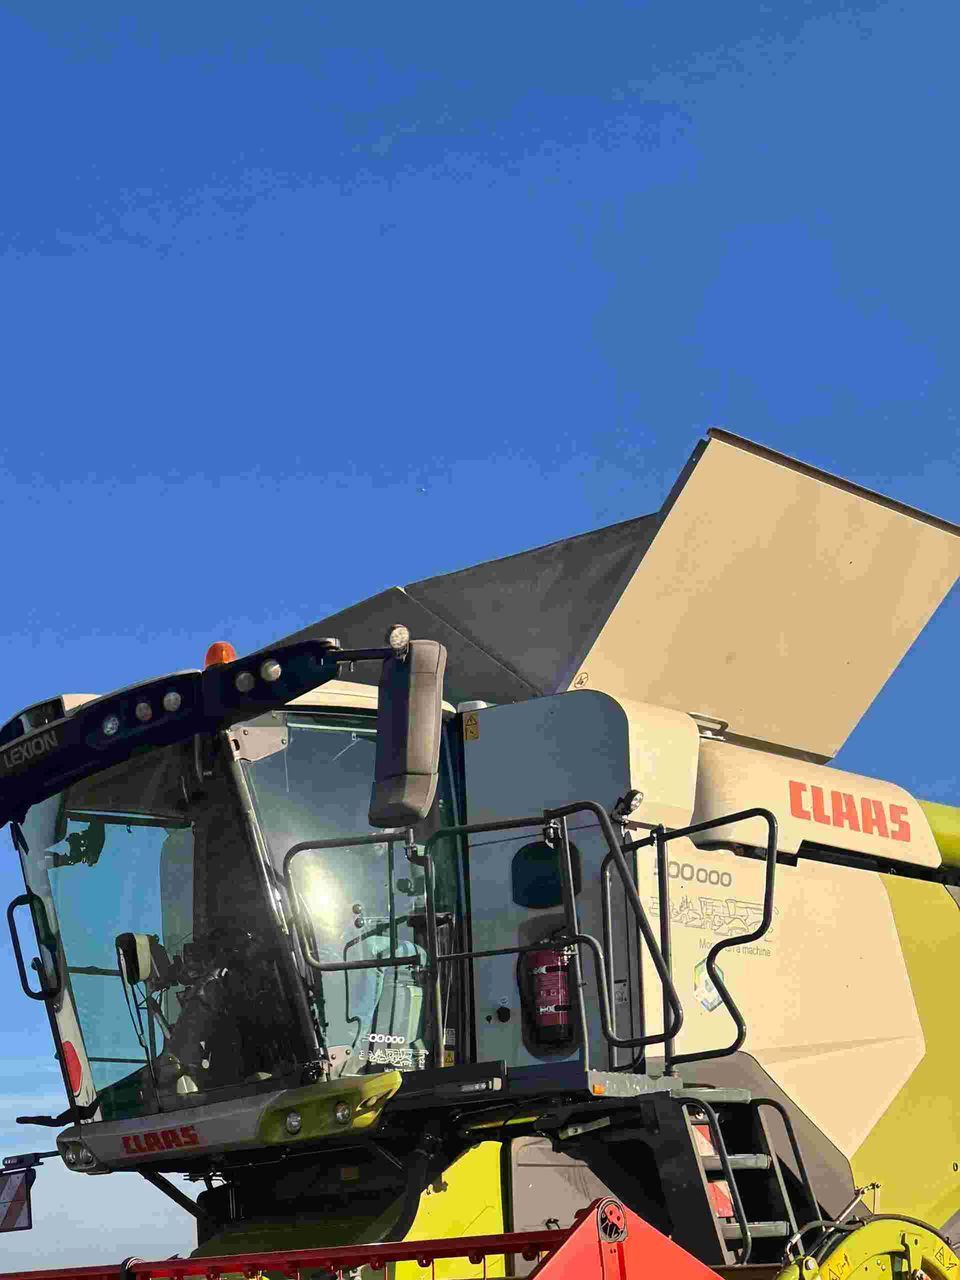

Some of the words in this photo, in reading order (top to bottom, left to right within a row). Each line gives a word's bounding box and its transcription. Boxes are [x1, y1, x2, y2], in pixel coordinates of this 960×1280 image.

[3, 730, 58, 768] LEXION
[788, 780, 911, 842] CLAAS
[121, 1125, 198, 1154] CLAAS
